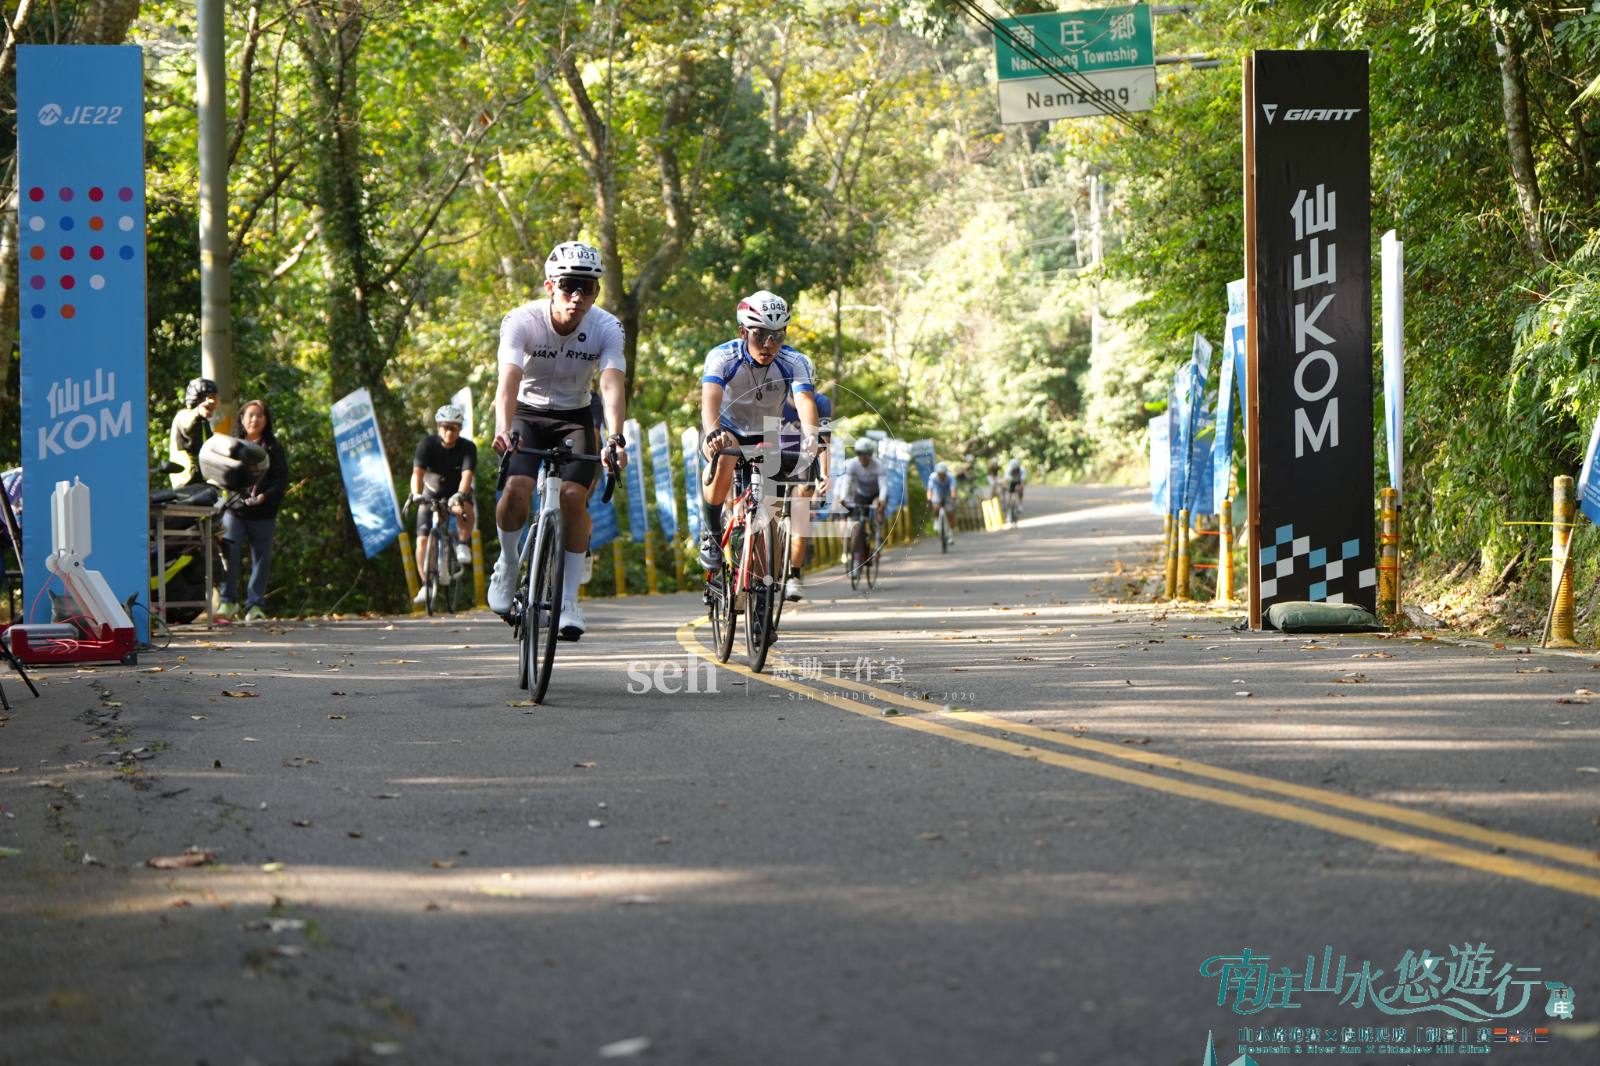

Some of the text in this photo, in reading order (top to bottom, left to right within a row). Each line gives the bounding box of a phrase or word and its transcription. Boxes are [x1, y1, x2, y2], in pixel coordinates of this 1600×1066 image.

[1008, 13, 1137, 48] 南庄鄉
[1083, 47, 1138, 65] Township
[63, 105, 122, 125] JE22
[1283, 108, 1362, 121] GIANT
[532, 350, 558, 359] VAN
[1293, 293, 1339, 459] KOM
[46, 367, 116, 419] 仙山
[38, 400, 133, 461] KOM
